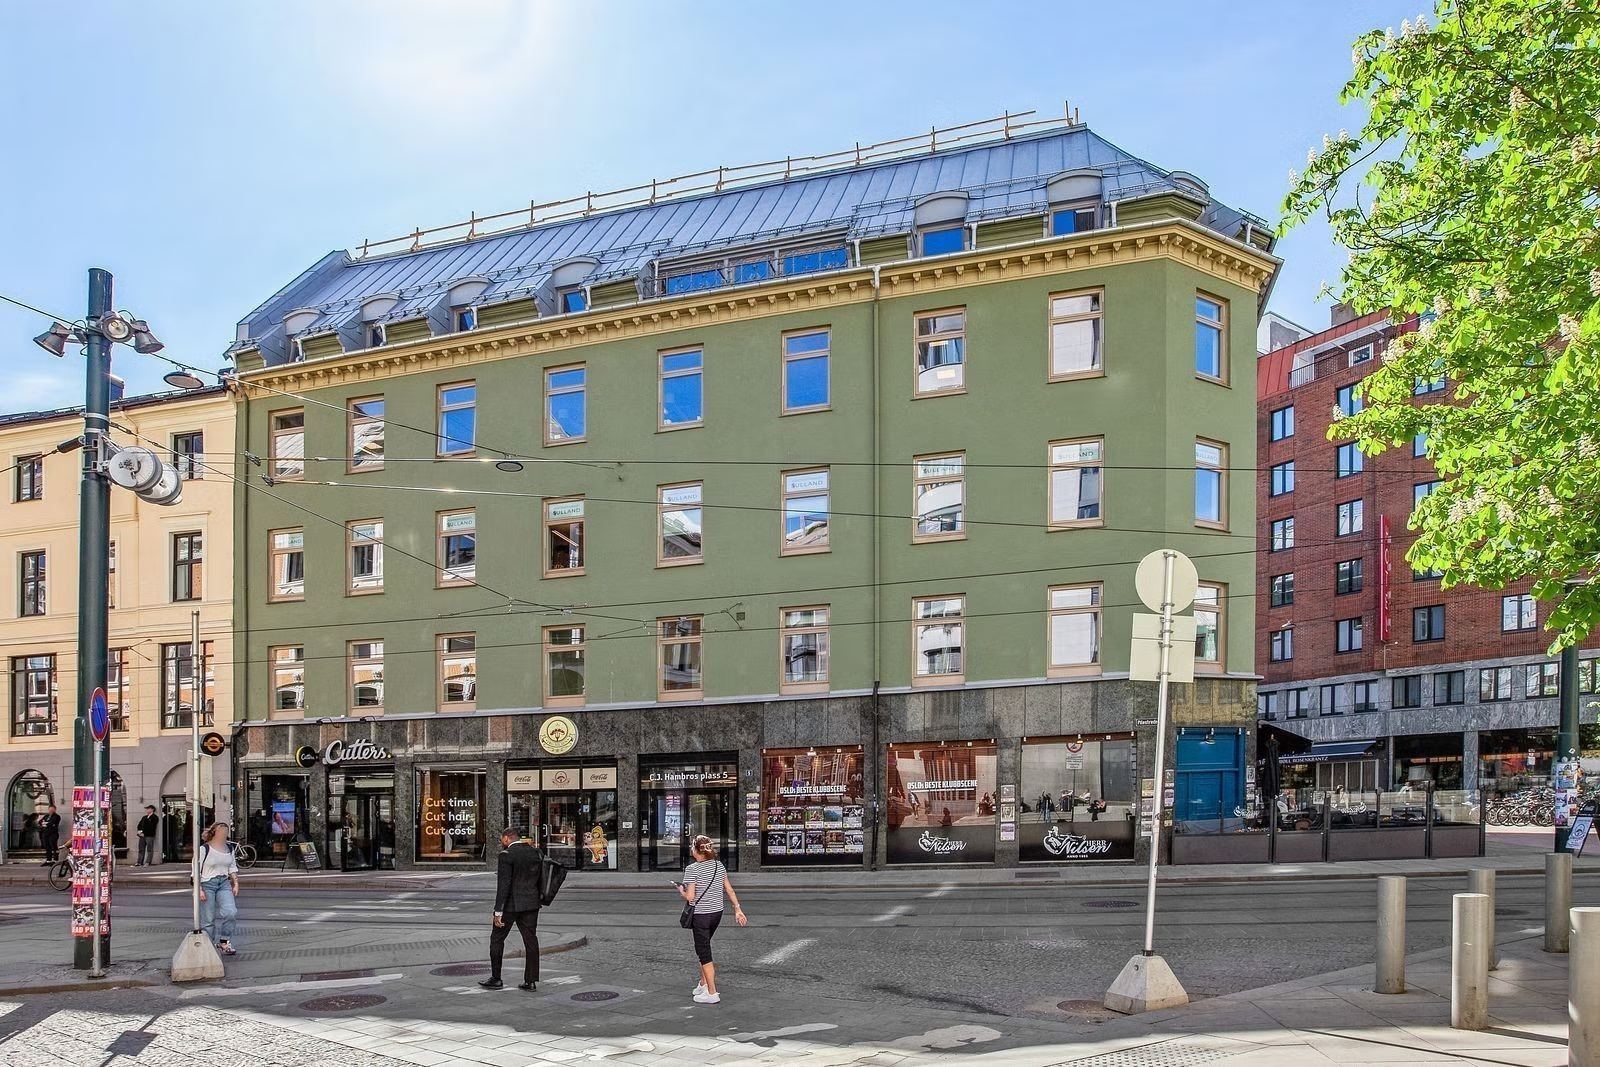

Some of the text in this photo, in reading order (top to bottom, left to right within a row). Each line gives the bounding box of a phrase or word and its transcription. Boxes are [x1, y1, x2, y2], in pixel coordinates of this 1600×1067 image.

[552, 507, 580, 516] SULLAND
[446, 519, 472, 528] SULLAND
[649, 771, 728, 781] C.J. Hambros plass 5
[925, 781, 941, 789] BESTE
[796, 786, 812, 794] BESTE
[425, 796, 478, 807] Cut time.
[425, 811, 446, 821] Cut
[425, 826, 446, 836] Cut
